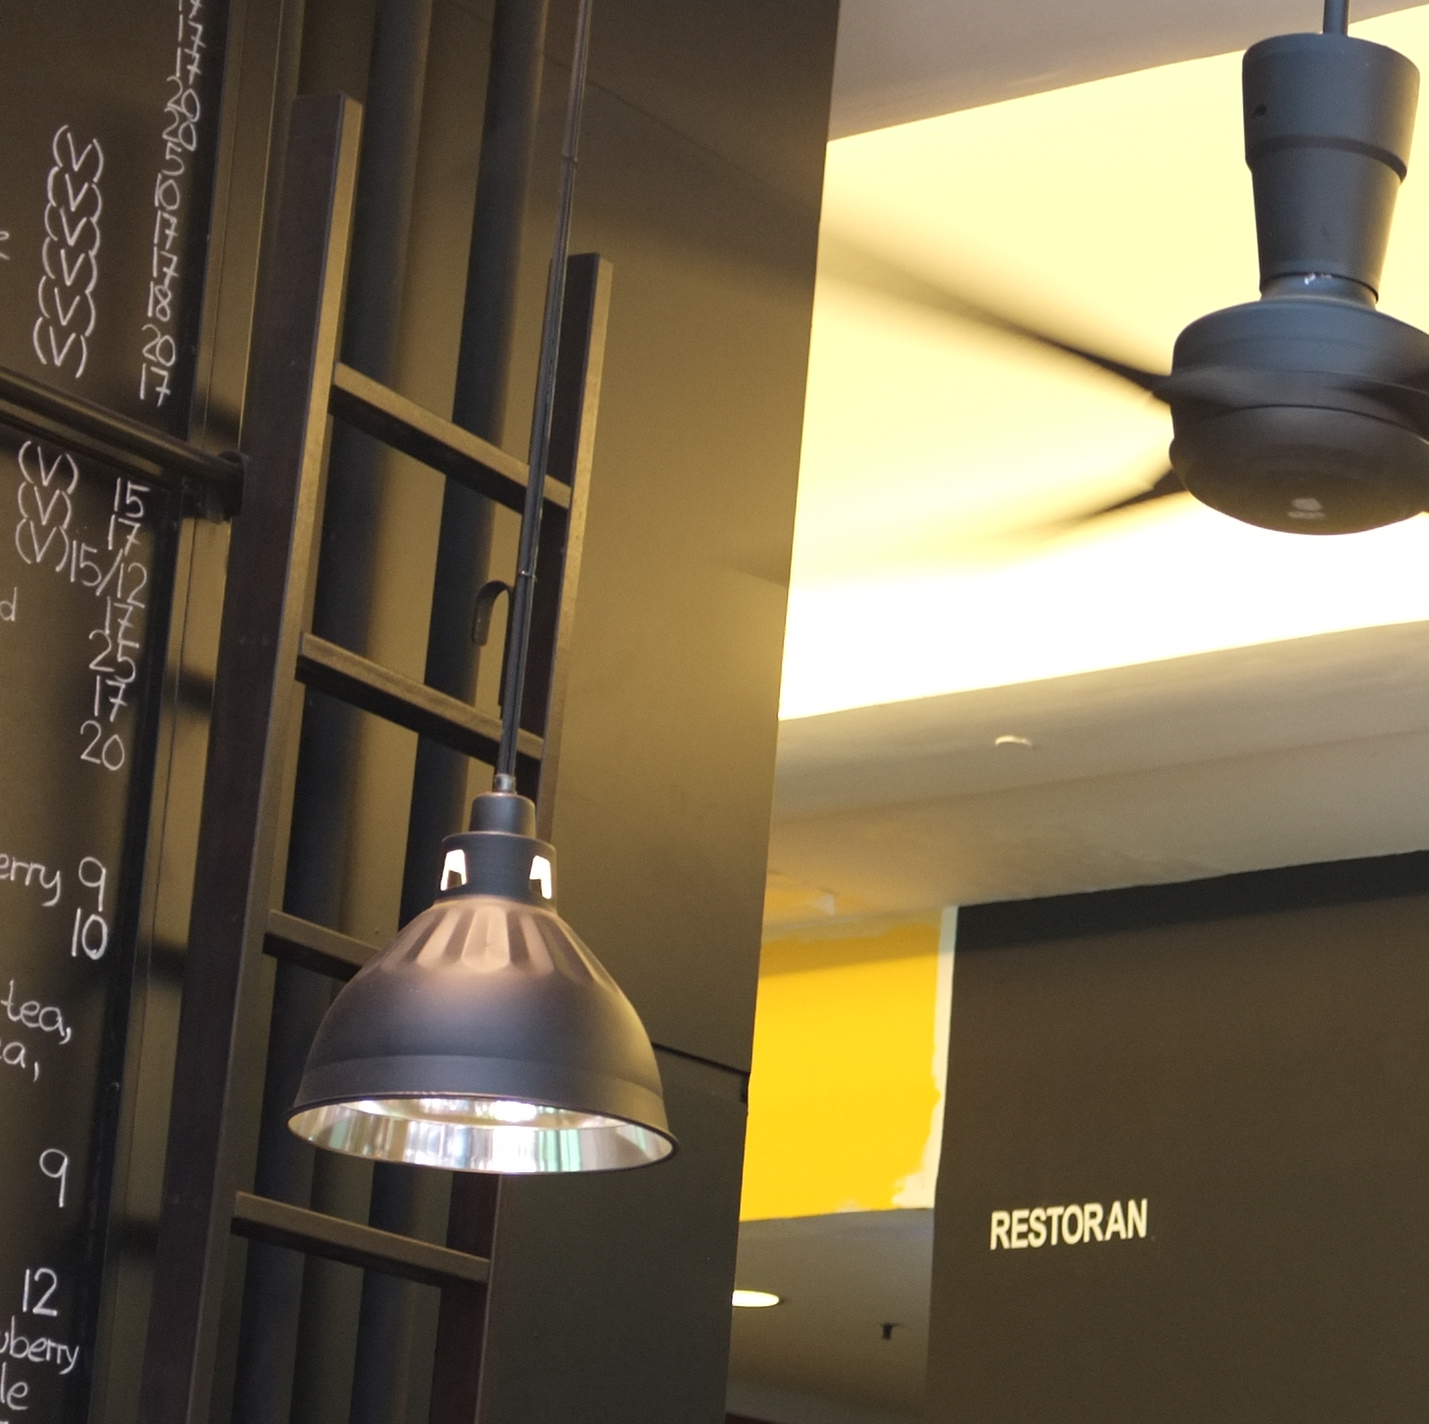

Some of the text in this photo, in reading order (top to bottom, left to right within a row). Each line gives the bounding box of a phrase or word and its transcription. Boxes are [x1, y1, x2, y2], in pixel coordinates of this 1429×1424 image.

[178, 14, 206, 58] 17
[176, 47, 201, 85] 17
[166, 75, 200, 122] 20
[162, 107, 197, 151] 20
[161, 141, 185, 176] 5
[155, 172, 180, 210] 10
[153, 209, 178, 250] 17
[152, 245, 178, 290] 17
[147, 280, 172, 322] 18
[141, 323, 176, 367] 20
[140, 363, 171, 407] 17
[18, 440, 151, 518] (V) 15
[18, 481, 141, 556] (V) 17
[15, 517, 70, 572] (V)
[105, 595, 133, 642] 17
[89, 629, 140, 684] 25
[94, 674, 129, 723] 17
[79, 720, 126, 772] 20
[78, 856, 107, 912] 9
[71, 907, 109, 960] 10
[39, 1148, 68, 1207] 9
[990, 1198, 1149, 1250] RESTORAN
[23, 1268, 58, 1316] 12
